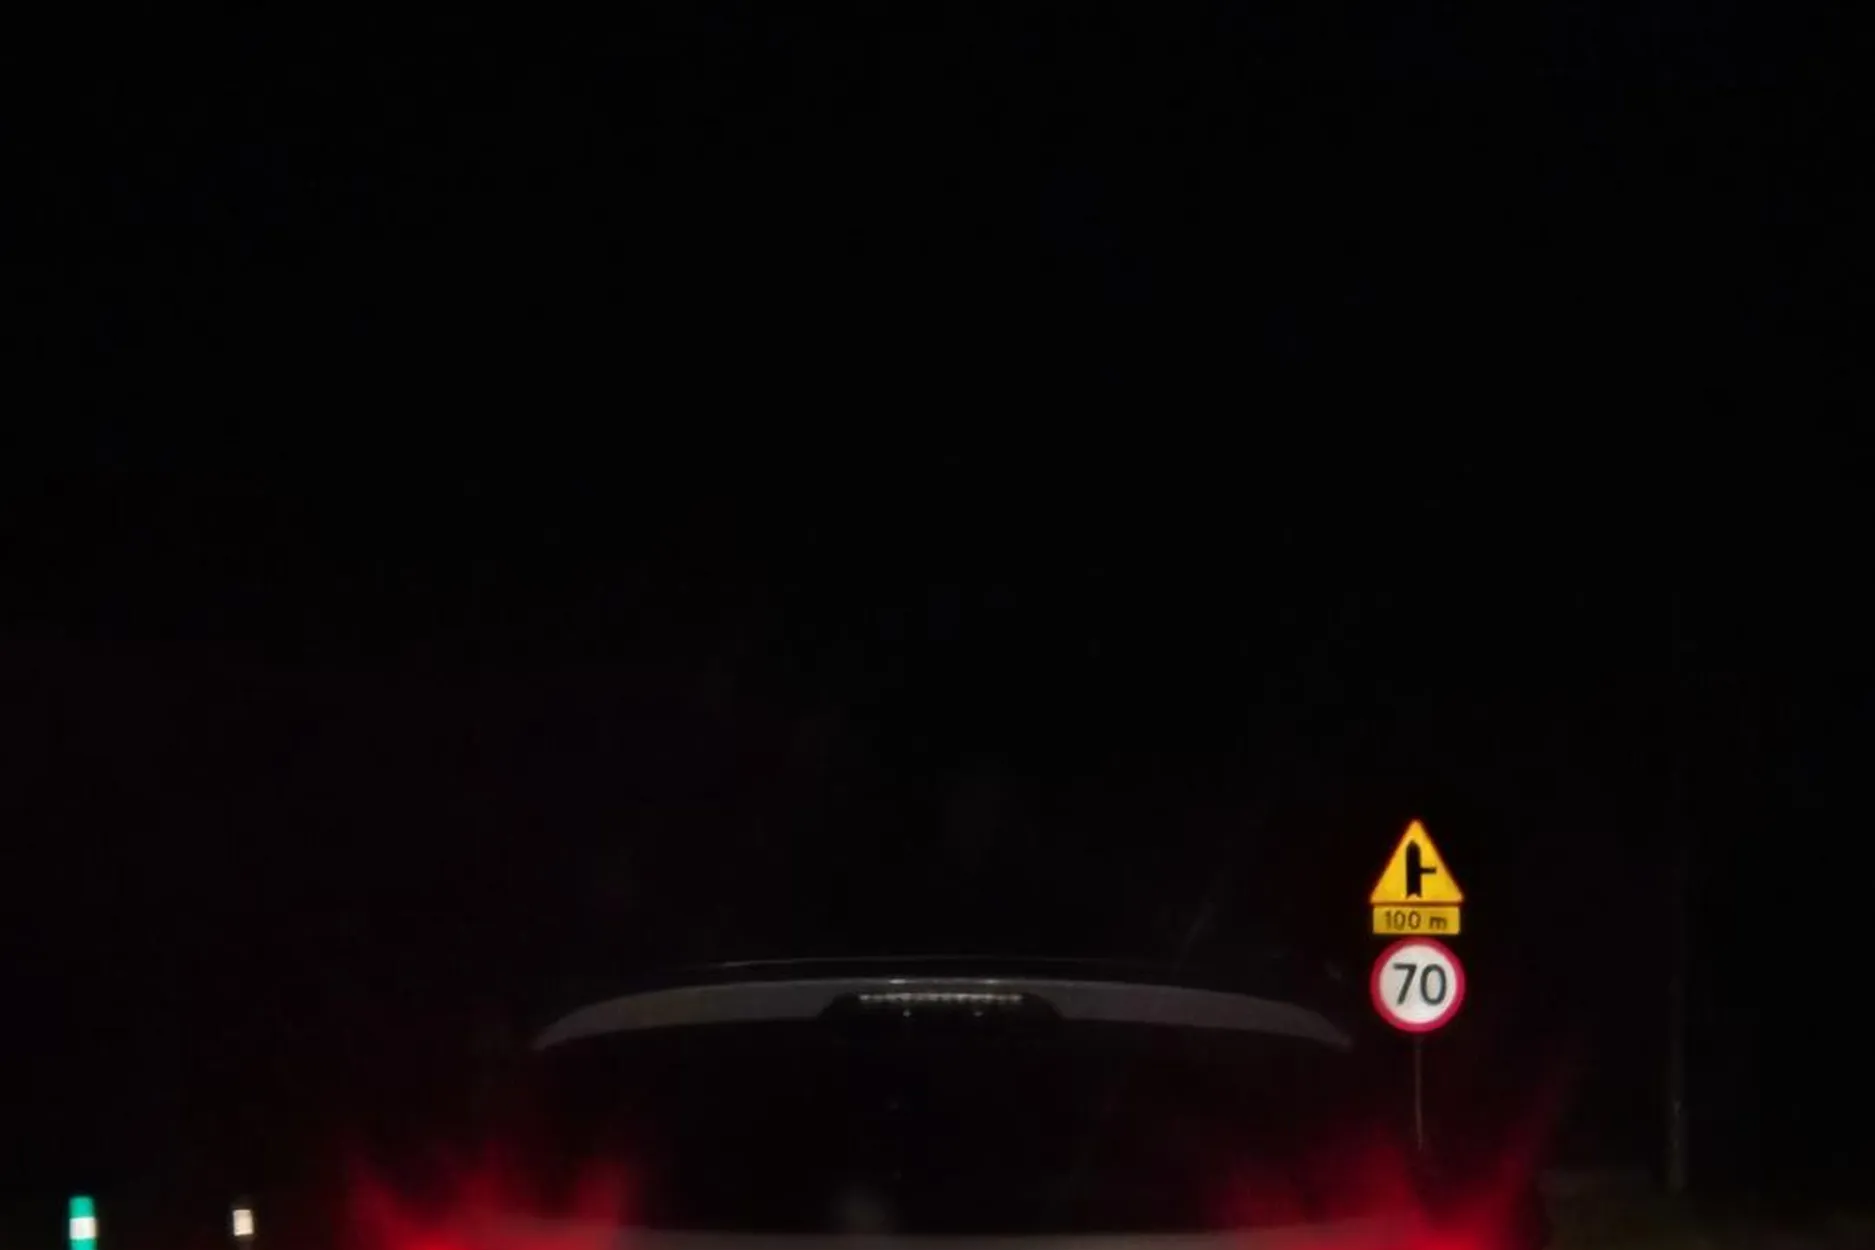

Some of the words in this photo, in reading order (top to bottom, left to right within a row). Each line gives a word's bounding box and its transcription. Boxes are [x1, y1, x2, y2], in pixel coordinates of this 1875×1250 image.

[1384, 910, 1421, 930] 100
[1429, 916, 1448, 930] m
[1392, 963, 1447, 1006] 70
